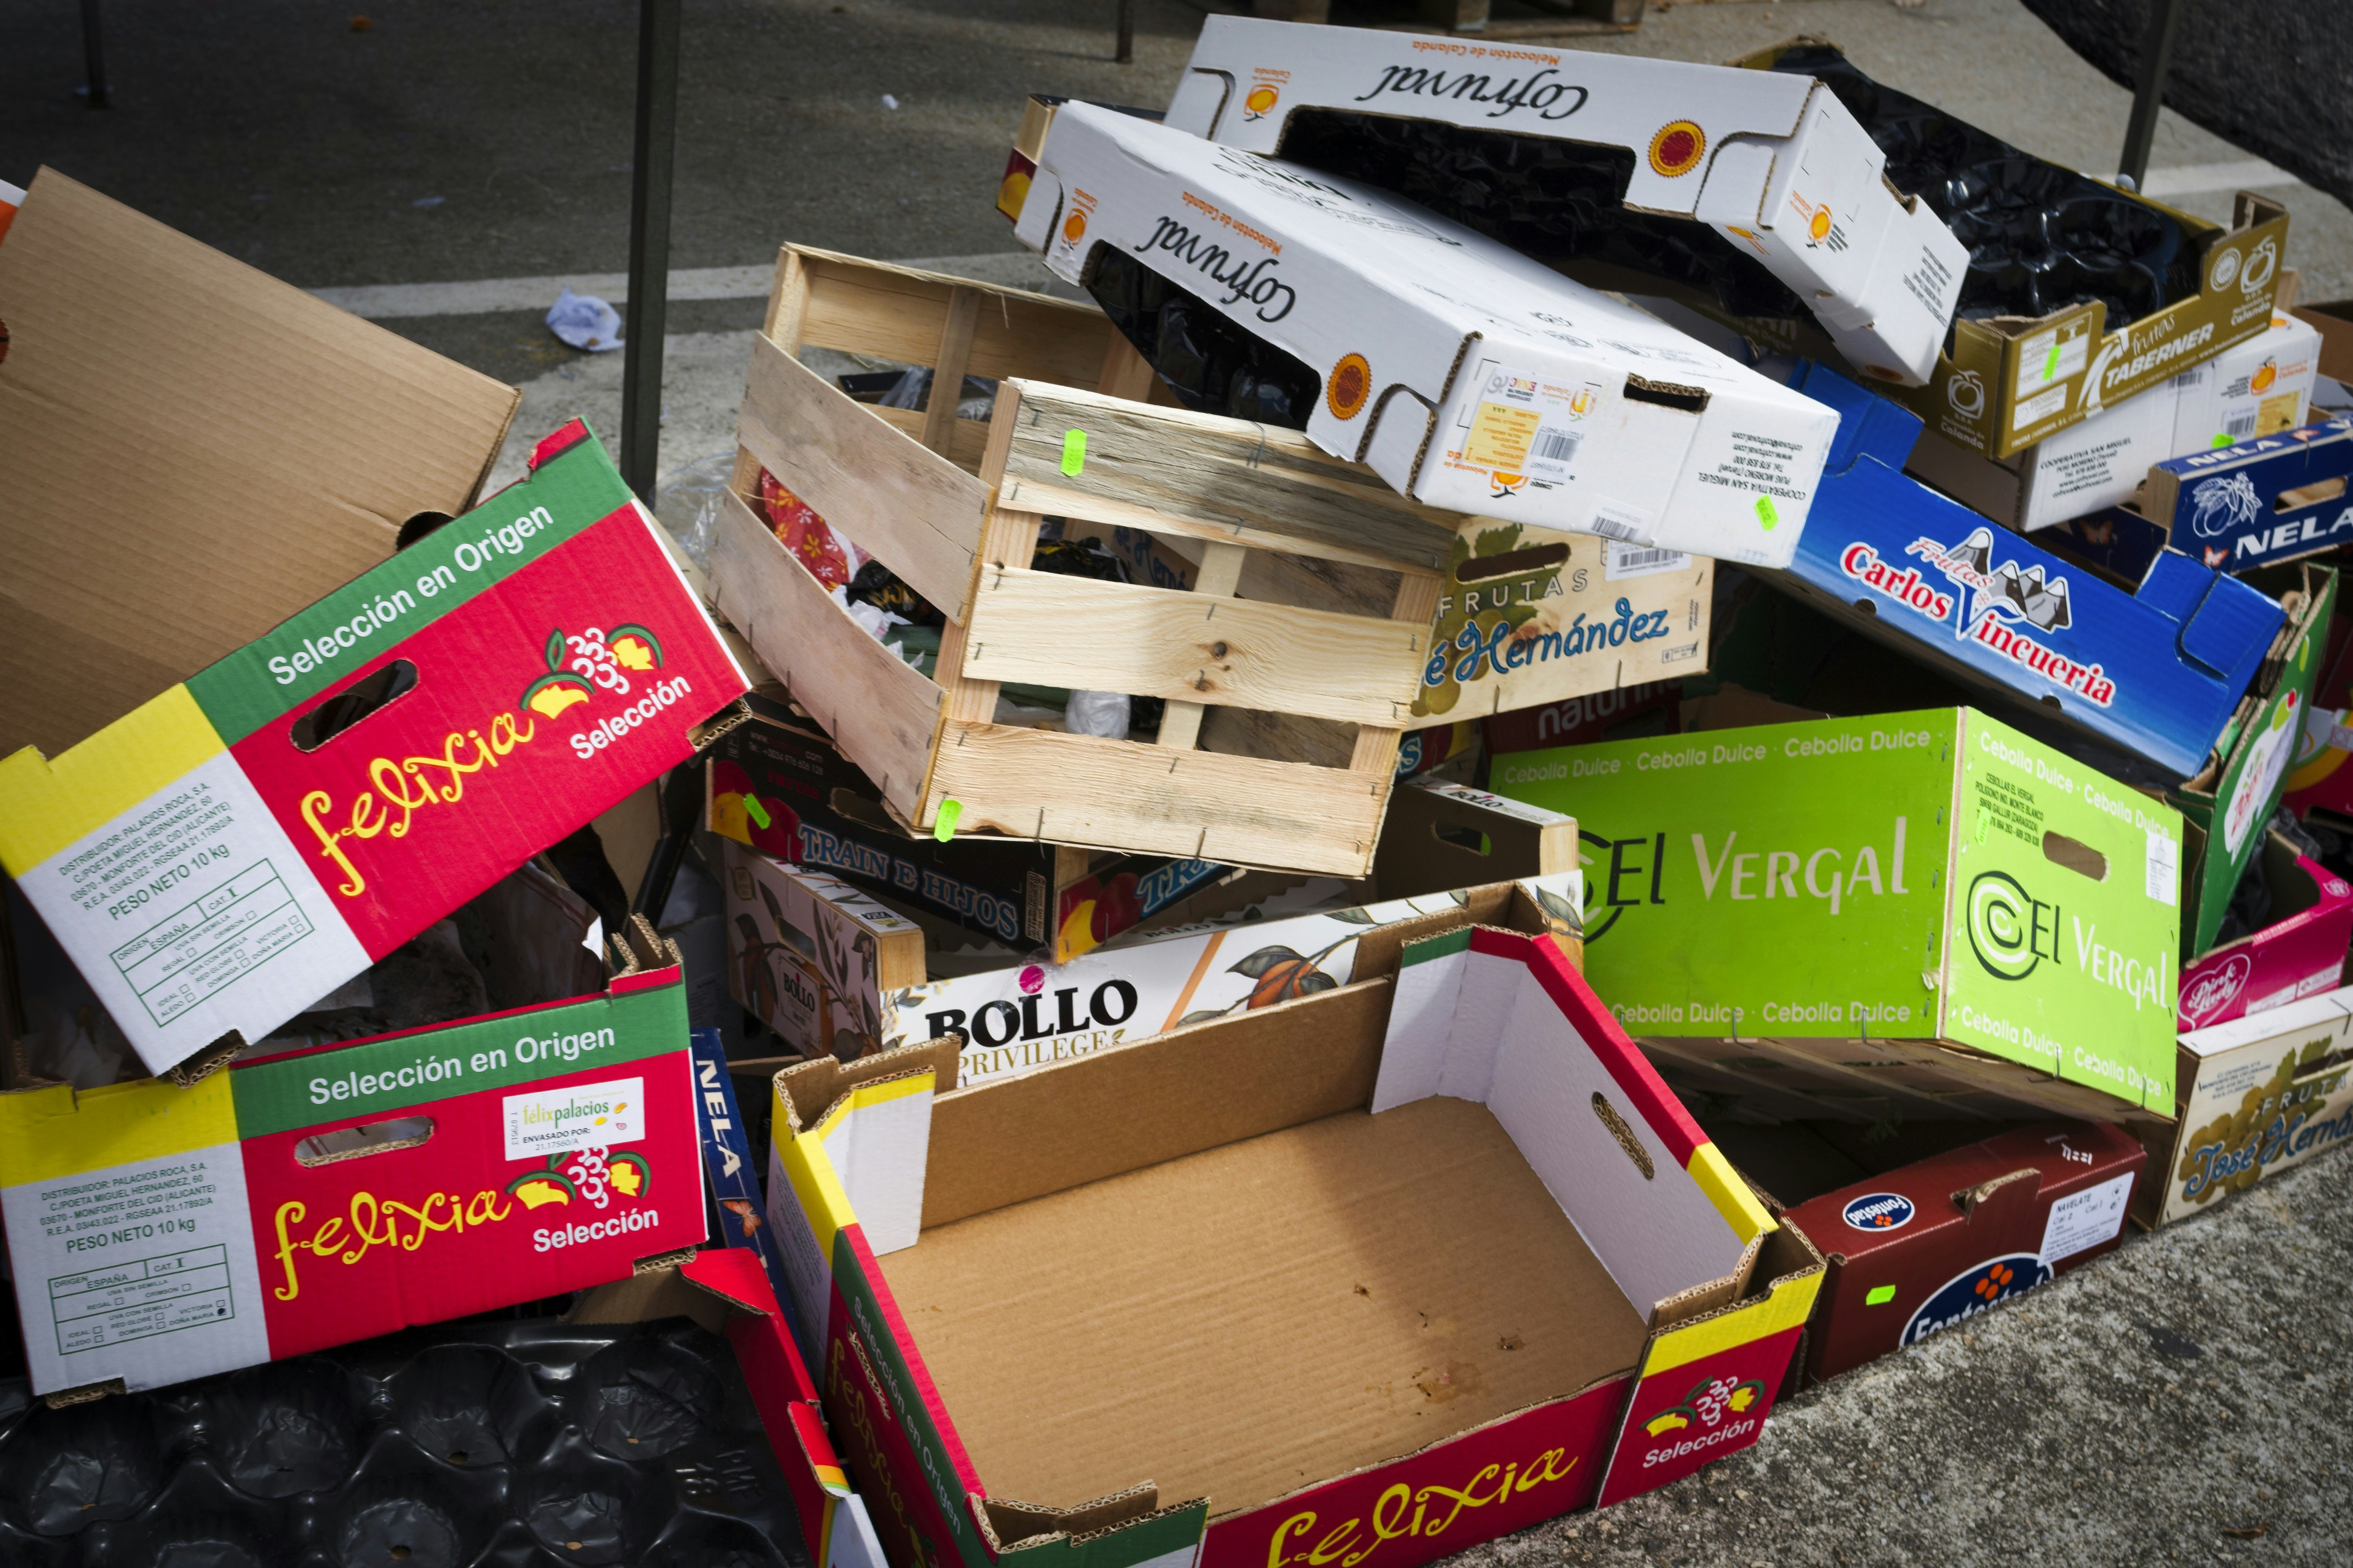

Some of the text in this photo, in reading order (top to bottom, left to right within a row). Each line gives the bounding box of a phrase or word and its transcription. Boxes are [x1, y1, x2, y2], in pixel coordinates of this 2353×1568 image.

[1412, 41, 1560, 66] Melocotón de Calanda
[1354, 65, 1588, 120] Cofruval
[1182, 191, 1219, 221] Calanda
[1219, 213, 1232, 228] de
[1134, 216, 1296, 323] Cofruval
[2106, 322, 2214, 388] TABERNER
[2187, 439, 2281, 469] NELA
[1698, 473, 1805, 500] COOPERATIVA SAN MIGUEL
[2236, 504, 2353, 559] NELA
[1841, 543, 1954, 621] Carlos
[1907, 537, 1995, 589] Frutas
[268, 505, 555, 685] Selección en Origen
[1438, 569, 1589, 618] FRUTAS
[1454, 597, 1670, 676] Hernández
[570, 674, 692, 760] Selección
[1504, 729, 1931, 785] Cebolla Dulce Cebolla Dulce Cebolla Dulce
[1980, 730, 2034, 775] Cebolla
[2037, 758, 2074, 795] Dulce
[2084, 782, 2133, 826] Cebolla
[299, 711, 535, 898] felixia
[766, 770, 823, 800] FRUTAS
[58, 783, 210, 876] DISTRIBUIDOR: PALACIOS ROCA, S.A.
[70, 801, 230, 901] 03670 MONFORTE DEL CID (ALICANTE)
[111, 836, 147, 860] MIGUEL
[145, 803, 202, 839] HERNANDEZ,
[82, 892, 109, 910] R.E.A.
[108, 844, 230, 920] PESO NETO 10 kg
[796, 823, 890, 881] TRAIN
[893, 860, 918, 892] E
[922, 869, 1021, 942] HIJOS
[147, 923, 189, 950] ESPAÑA
[201, 915, 231, 934] SEMILLA
[219, 936, 248, 956] SEMILLA
[925, 977, 1138, 1051] BOLLO
[1611, 1001, 1911, 1024] Cebolla Dulce Cebolla Dulce
[309, 1027, 616, 1105] Selección en Origen
[1961, 1004, 2162, 1097] Cebolla Dulce Cebolla Dulce
[524, 1130, 570, 1144] ENVASADO
[696, 1058, 742, 1179] NELA
[41, 1162, 207, 1201] DISTRIBUIDOR: PALACIOS ROCA, S.A.
[2185, 1130, 2261, 1197] José
[39, 1184, 215, 1225] 03670 MONFORTE DEL CID (ALICANTE)
[94, 1174, 203, 1202] MIGUEL HERNANDEZ, 60
[1847, 1196, 1906, 1226] Fontestad
[2058, 1194, 2091, 1212] NAVELATE
[46, 1225, 74, 1236] R.E.A.
[66, 1218, 195, 1253] PESO NETO 10 kg
[273, 1190, 512, 1301] felixia
[533, 1209, 659, 1254] Selección
[85, 1274, 128, 1289] ESPAÑA
[86, 1287, 178, 1310] REGAL CRIMSON
[137, 1279, 168, 1290] SEMILLA
[65, 1338, 91, 1348] ALEDO
[118, 1325, 153, 1336] DOMINGA
[191, 1312, 214, 1321] MARIA
[67, 1330, 90, 1338] IDEAL
[126, 1316, 152, 1325] GLOBE
[178, 1303, 213, 1314] VICTORIA
[142, 1303, 173, 1313] SEMILLA
[853, 1295, 963, 1536] Selección en Origen
[1641, 1416, 1756, 1470] Selección
